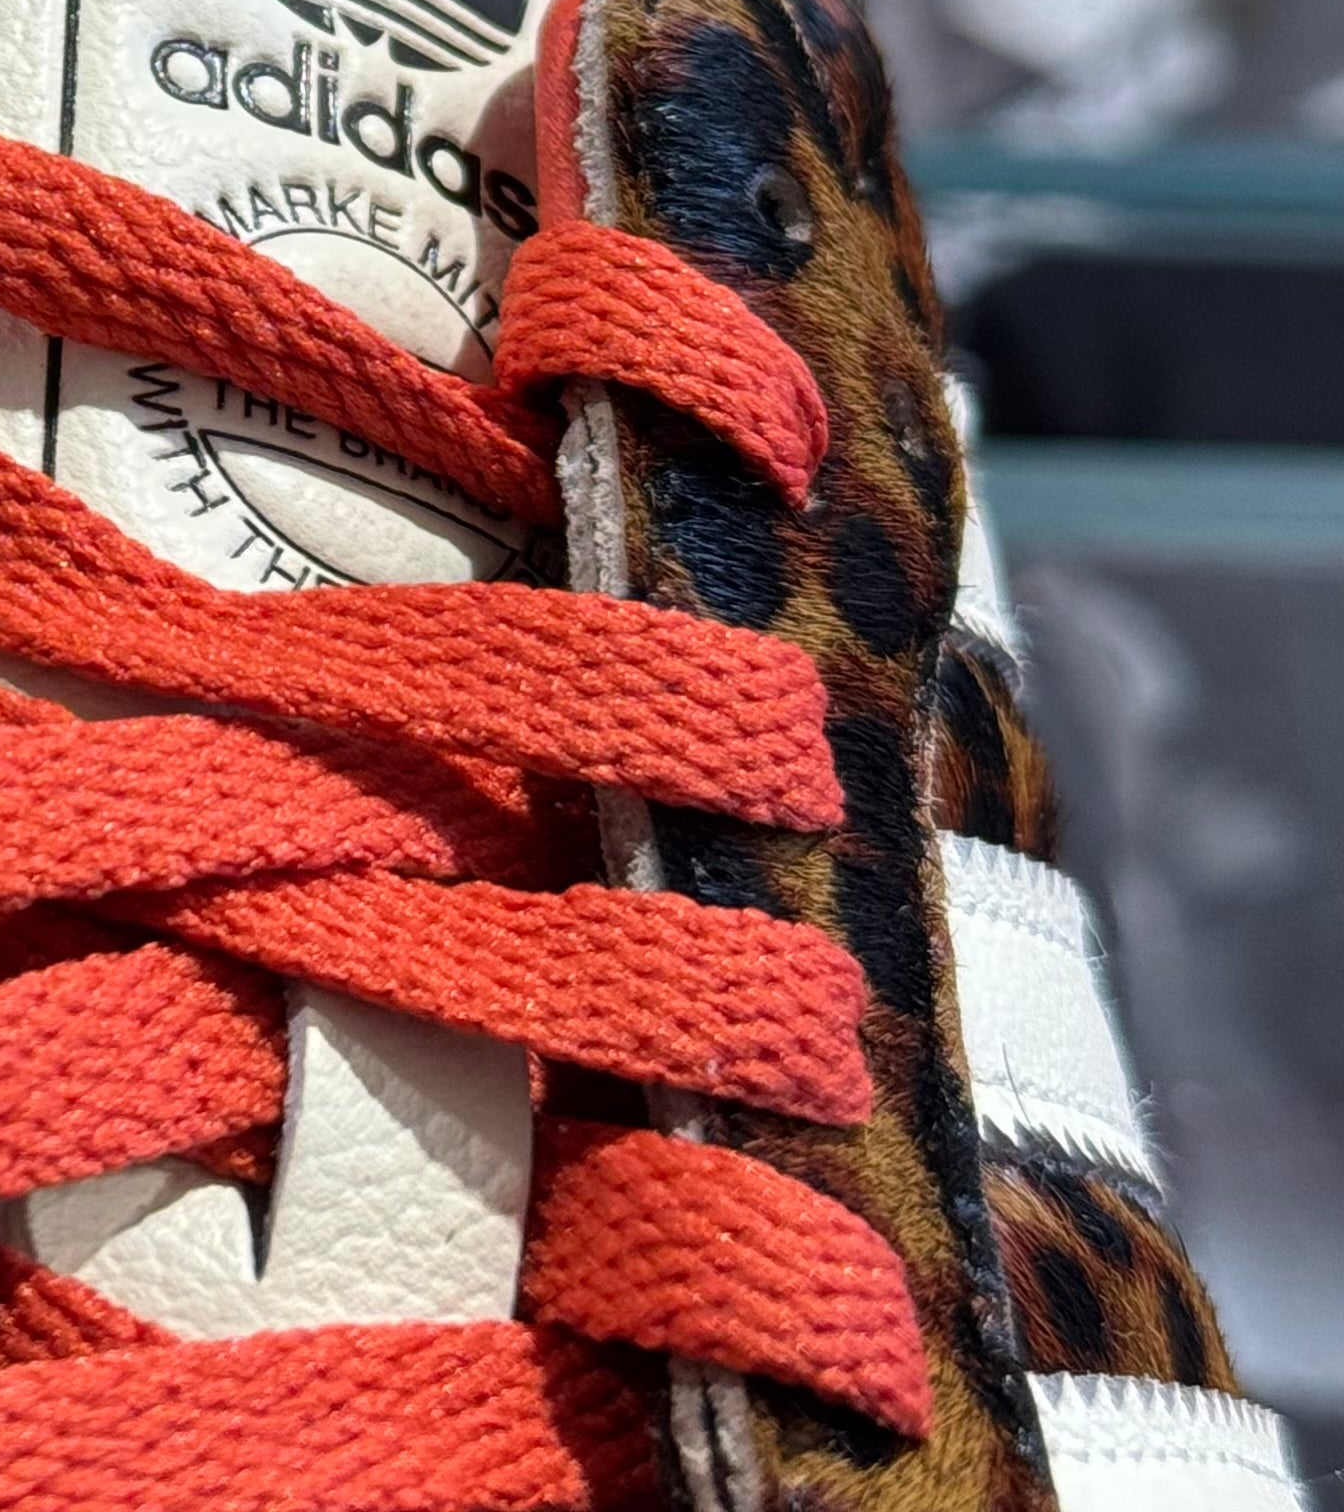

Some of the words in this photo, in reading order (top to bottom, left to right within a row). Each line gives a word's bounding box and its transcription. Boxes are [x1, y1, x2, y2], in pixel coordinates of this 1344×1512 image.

[150, 37, 539, 242] adidas
[417, 233, 500, 330] MIT
[127, 361, 231, 517] WITH
